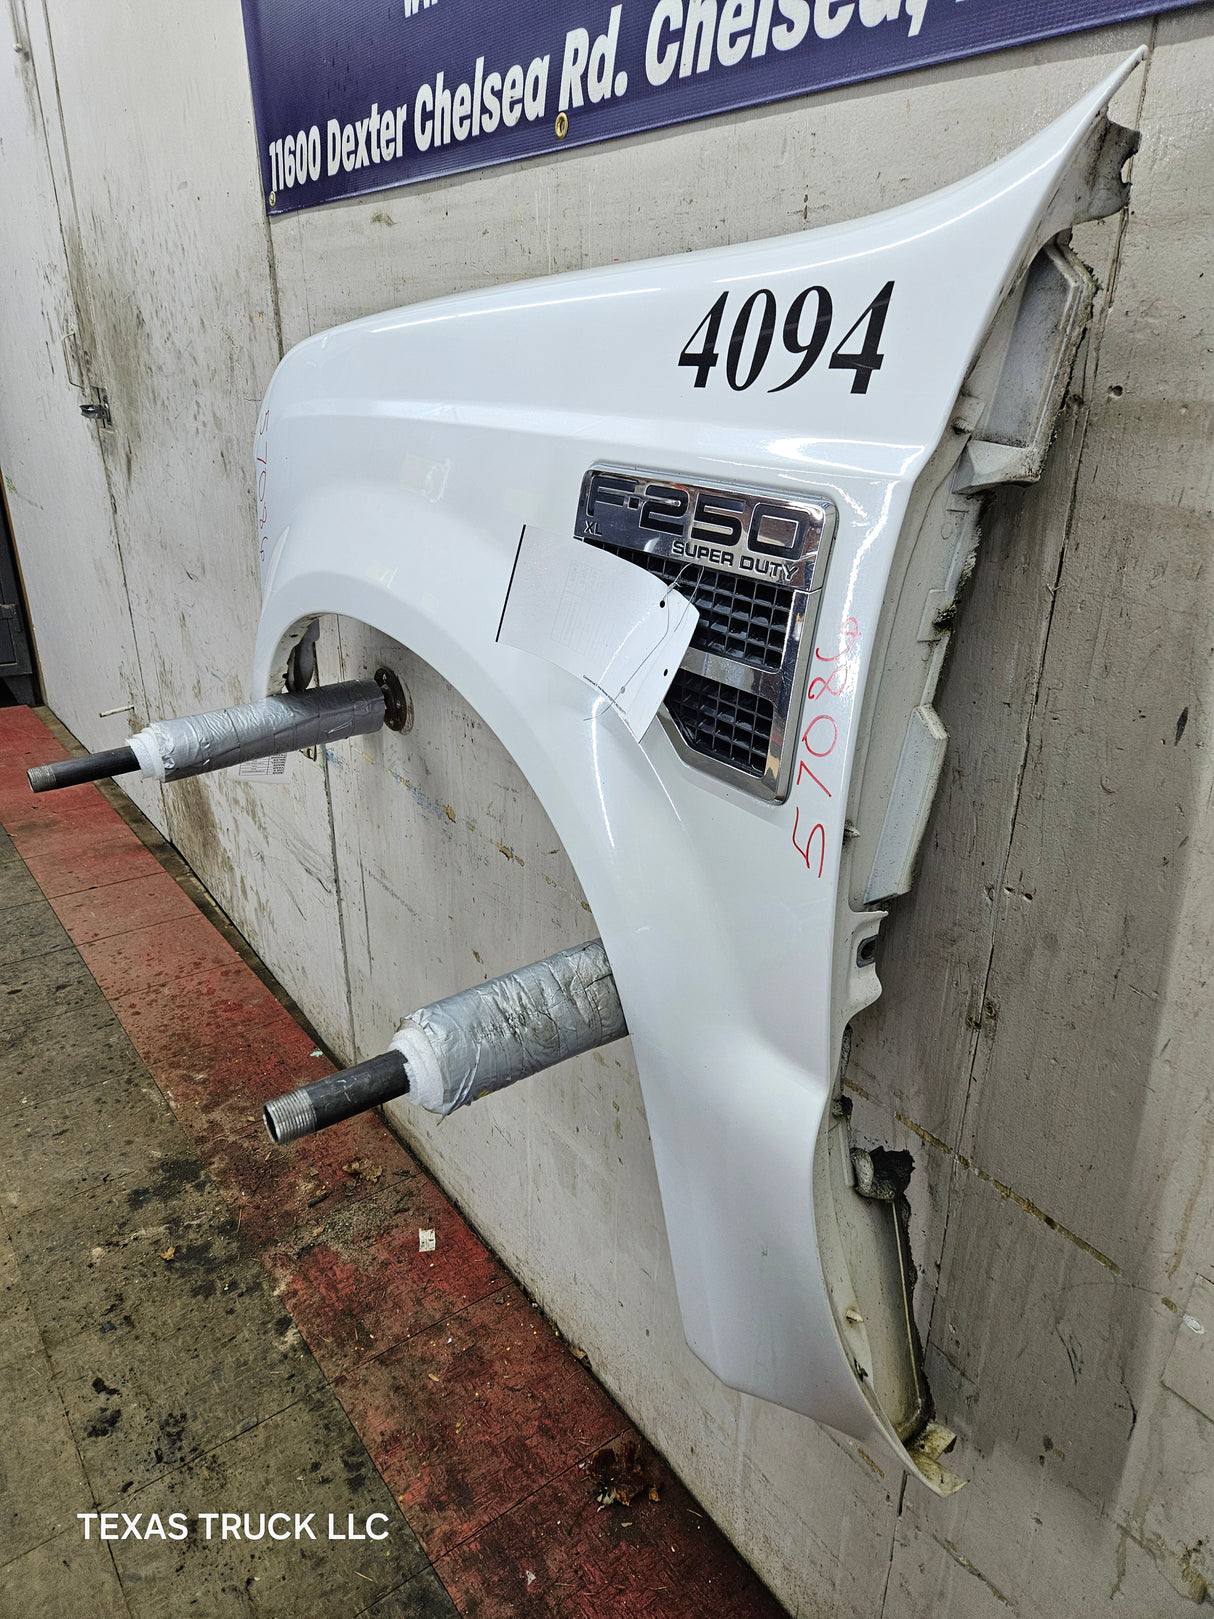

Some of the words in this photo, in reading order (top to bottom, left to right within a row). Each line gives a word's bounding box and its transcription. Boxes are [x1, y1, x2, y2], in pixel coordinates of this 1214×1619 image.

[269, 125, 321, 191] 11600
[327, 103, 407, 177] Dexter
[414, 56, 551, 152] Chelsea
[557, 4, 629, 112] Rd.
[678, 280, 896, 395] 4094
[584, 521, 603, 537] XL
[671, 540, 735, 567] SUPER
[738, 554, 800, 583] DUTY
